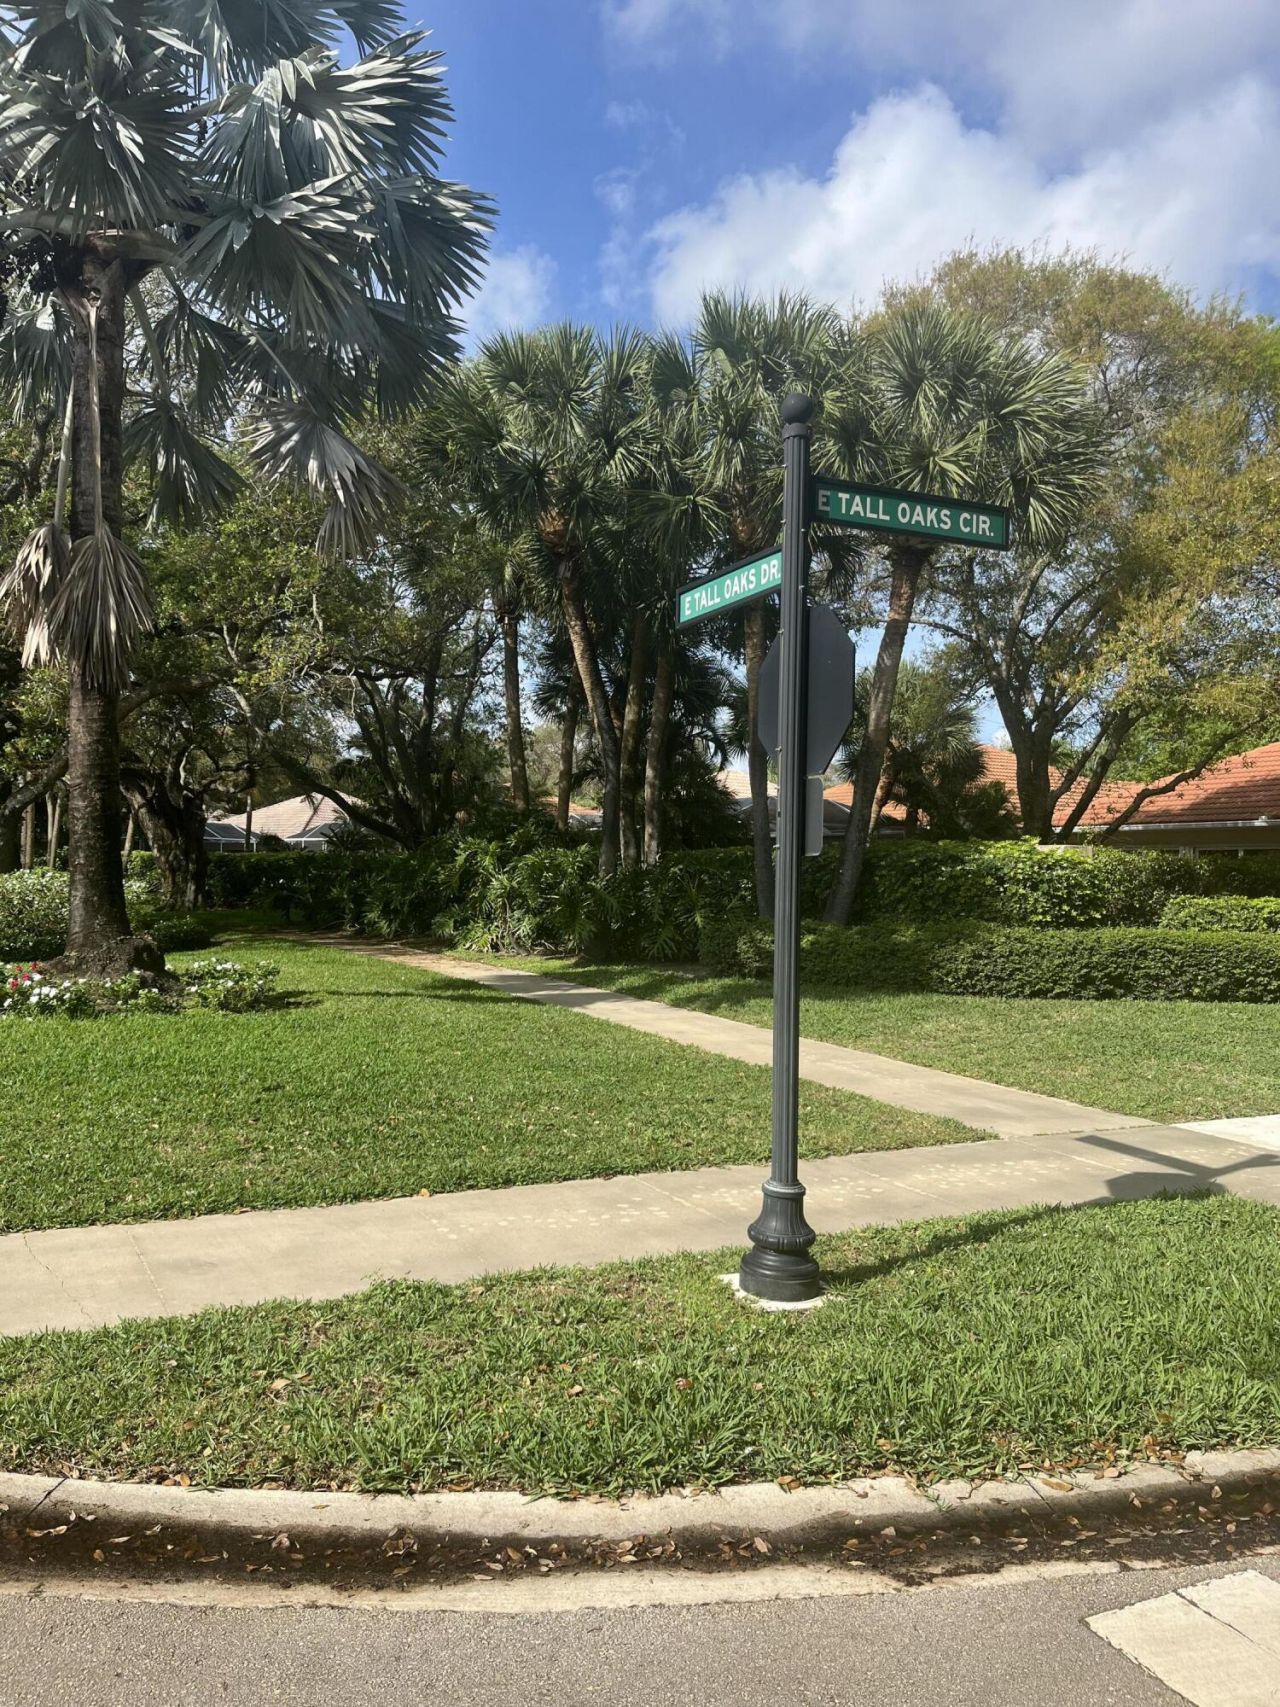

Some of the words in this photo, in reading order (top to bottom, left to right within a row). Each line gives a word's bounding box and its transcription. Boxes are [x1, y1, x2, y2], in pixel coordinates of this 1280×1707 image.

[818, 490, 831, 511] E
[838, 493, 890, 521] TALL
[897, 503, 951, 529] OAKS
[959, 513, 994, 537] CIR.
[684, 596, 692, 616] E
[694, 584, 721, 612] TALL
[724, 568, 756, 599] OAKS
[760, 559, 781, 585] DR.
